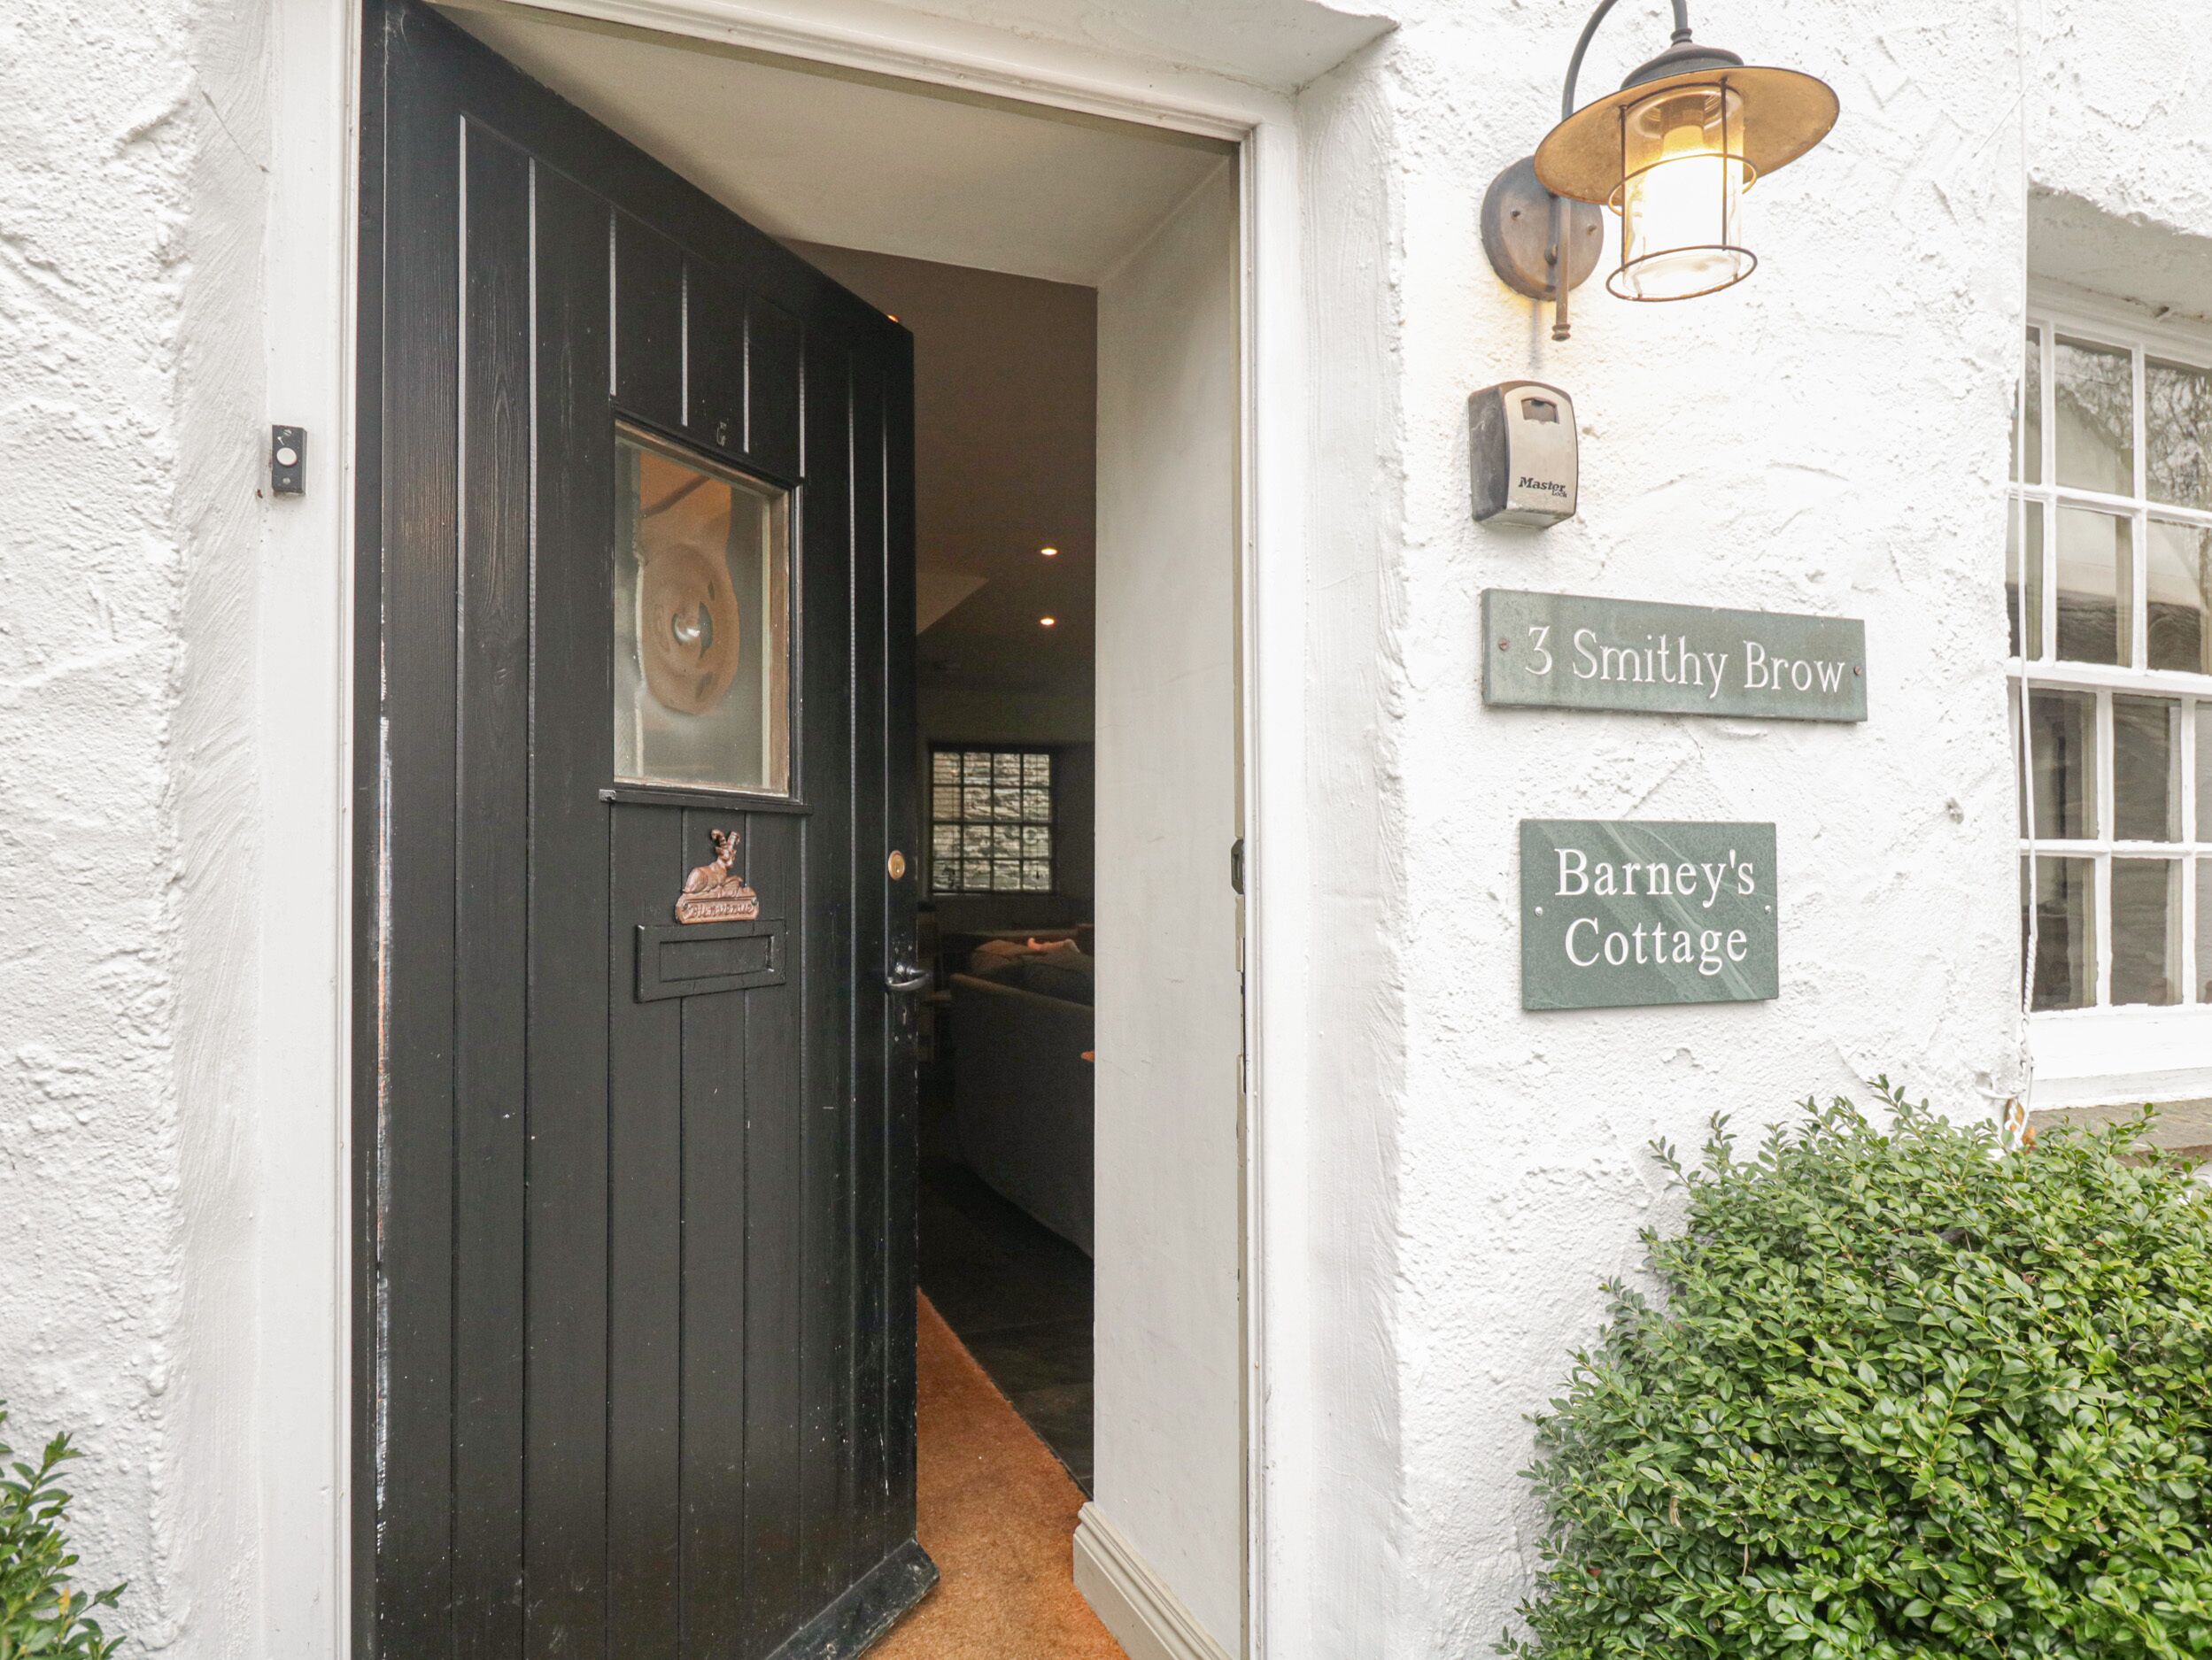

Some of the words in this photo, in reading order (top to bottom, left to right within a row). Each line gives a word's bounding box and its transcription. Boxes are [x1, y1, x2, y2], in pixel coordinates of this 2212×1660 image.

[1518, 476, 1566, 492] Master
[1551, 490, 1567, 498] Lock
[1525, 626, 1553, 676] 3
[1573, 629, 1729, 699] Smithy
[1743, 640, 1845, 693] Brow
[1554, 848, 1755, 908] Barney's
[1565, 917, 1747, 976] Cottage
